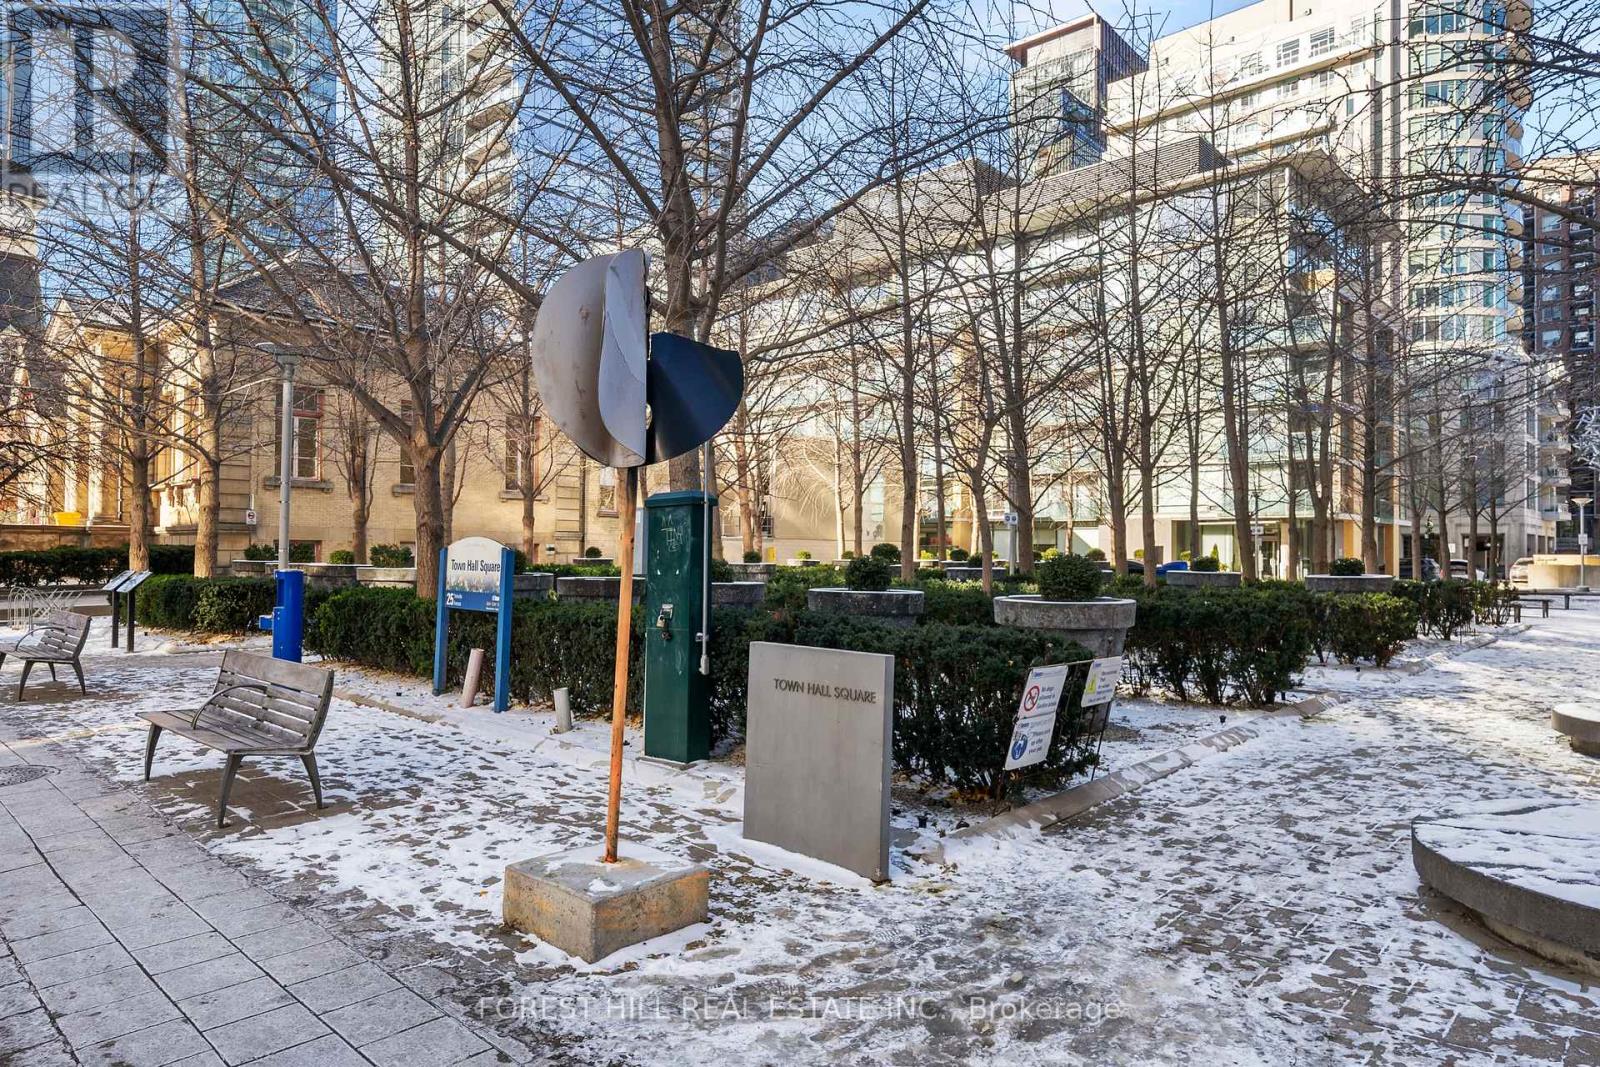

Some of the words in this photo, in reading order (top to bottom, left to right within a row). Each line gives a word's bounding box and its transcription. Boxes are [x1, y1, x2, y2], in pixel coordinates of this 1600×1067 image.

[451, 559, 466, 571] Town
[467, 560, 479, 571] Hall
[480, 560, 501, 574] Square
[446, 593, 454, 606] 25
[774, 678, 804, 693] TOWN
[807, 683, 832, 697] HALL
[834, 687, 877, 704] SQUARE
